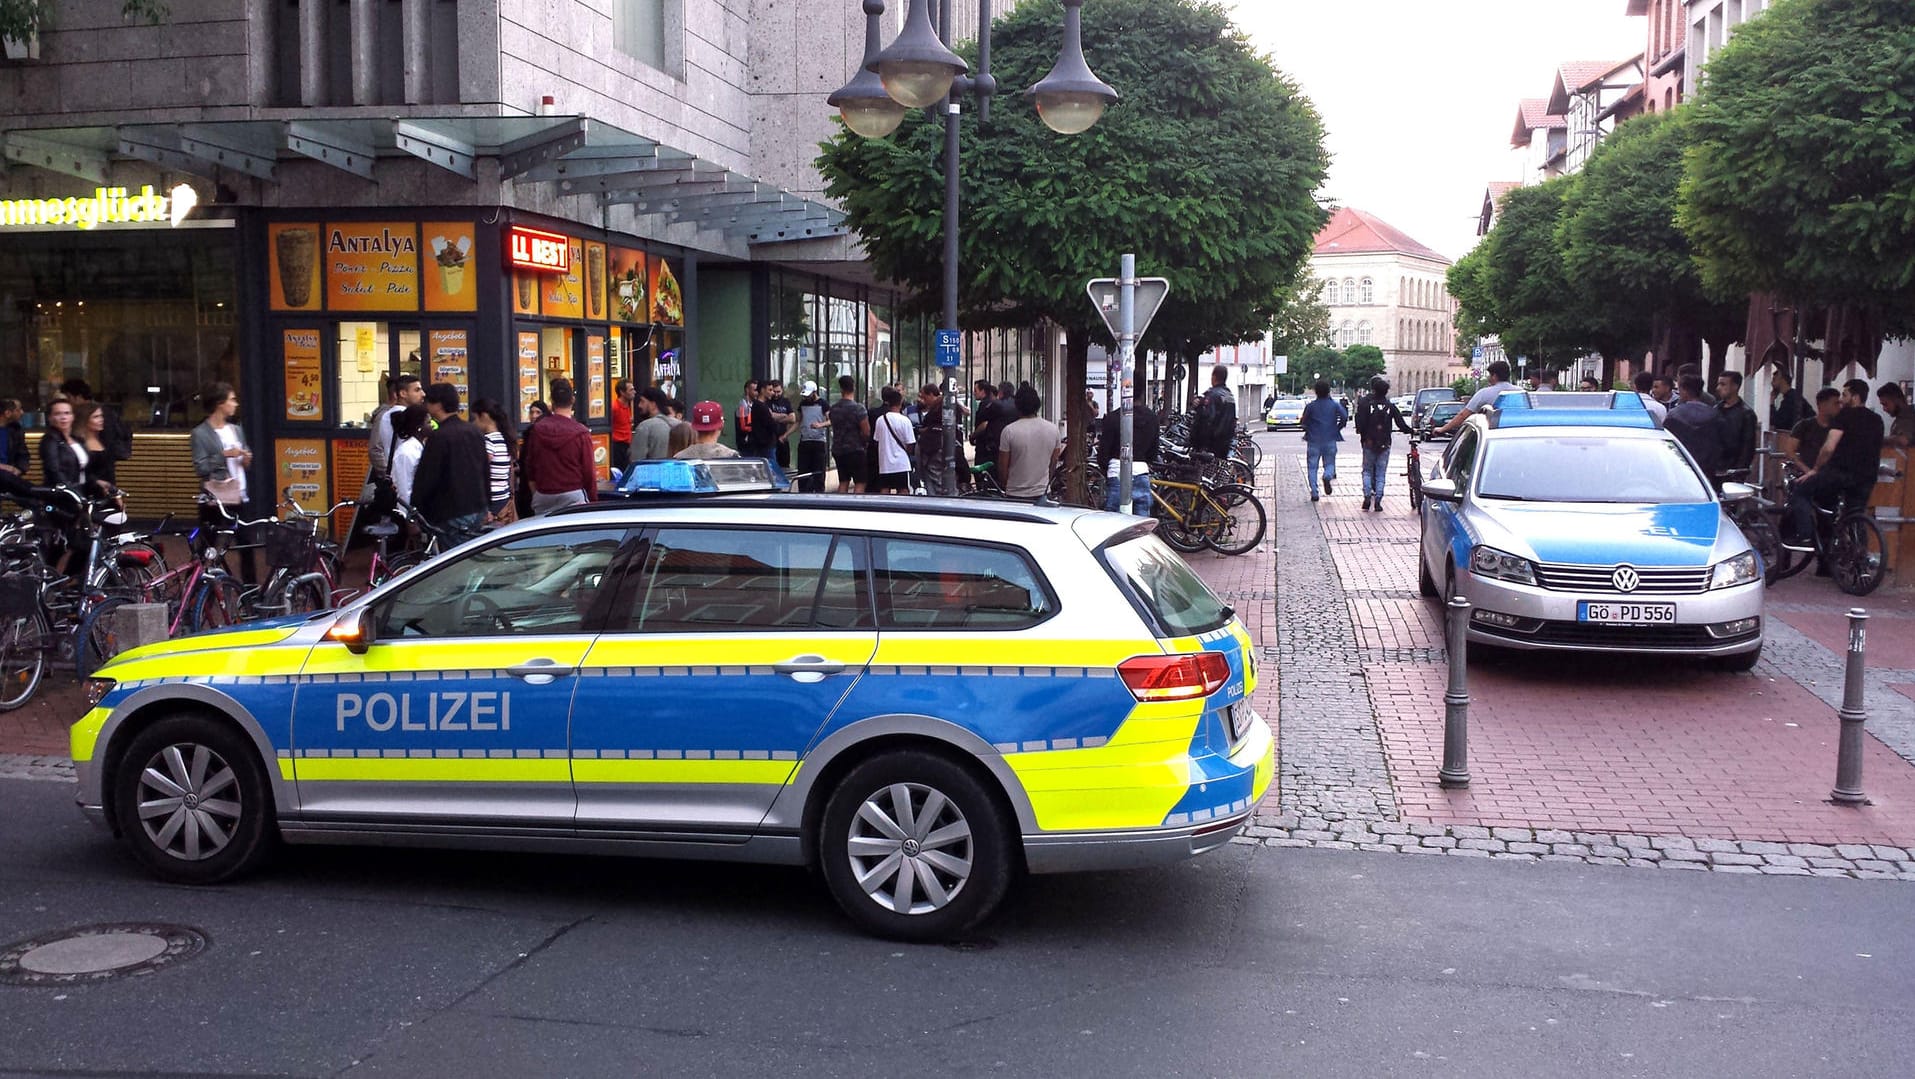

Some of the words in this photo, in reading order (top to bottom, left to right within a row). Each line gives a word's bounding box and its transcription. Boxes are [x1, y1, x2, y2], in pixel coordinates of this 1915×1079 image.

[532, 238, 566, 267] BEST
[1589, 605, 1609, 619] GÖ
[1620, 606, 1641, 620] PD
[1644, 607, 1673, 620] 556
[336, 692, 511, 732] POLIZEI
